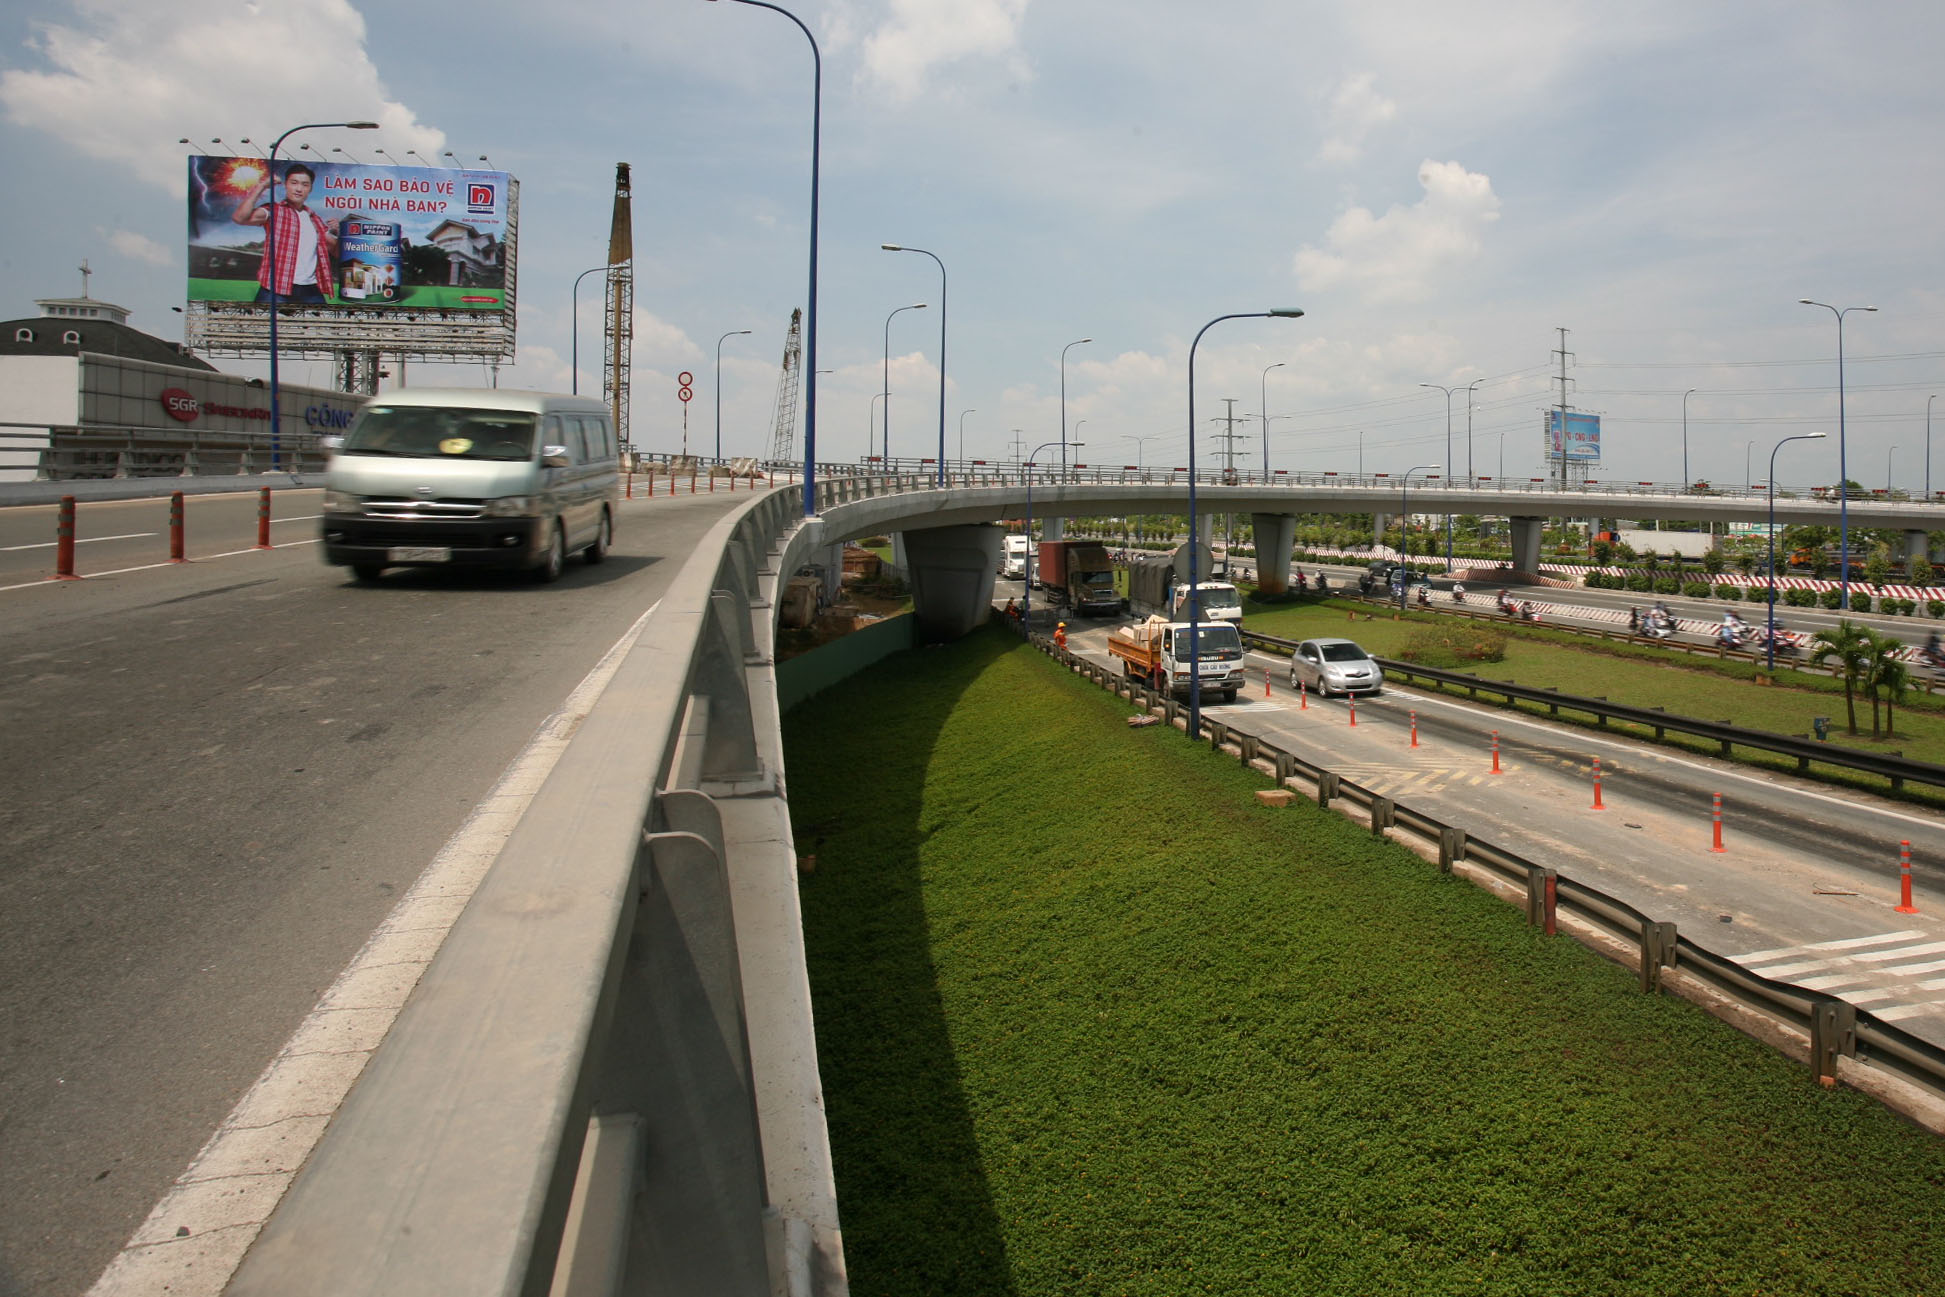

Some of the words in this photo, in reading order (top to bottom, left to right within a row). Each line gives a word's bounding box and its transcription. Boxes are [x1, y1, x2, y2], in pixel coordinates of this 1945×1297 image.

[325, 174, 356, 190] LÀM
[363, 178, 393, 191] SAO
[399, 177, 430, 193] BẢO
[436, 179, 454, 197] VỆ
[325, 194, 362, 209] NGÔI
[368, 196, 400, 211] NHÀ
[406, 200, 447, 214] BẠN?
[343, 242, 399, 253] WeatherGard
[169, 397, 198, 412] SGR
